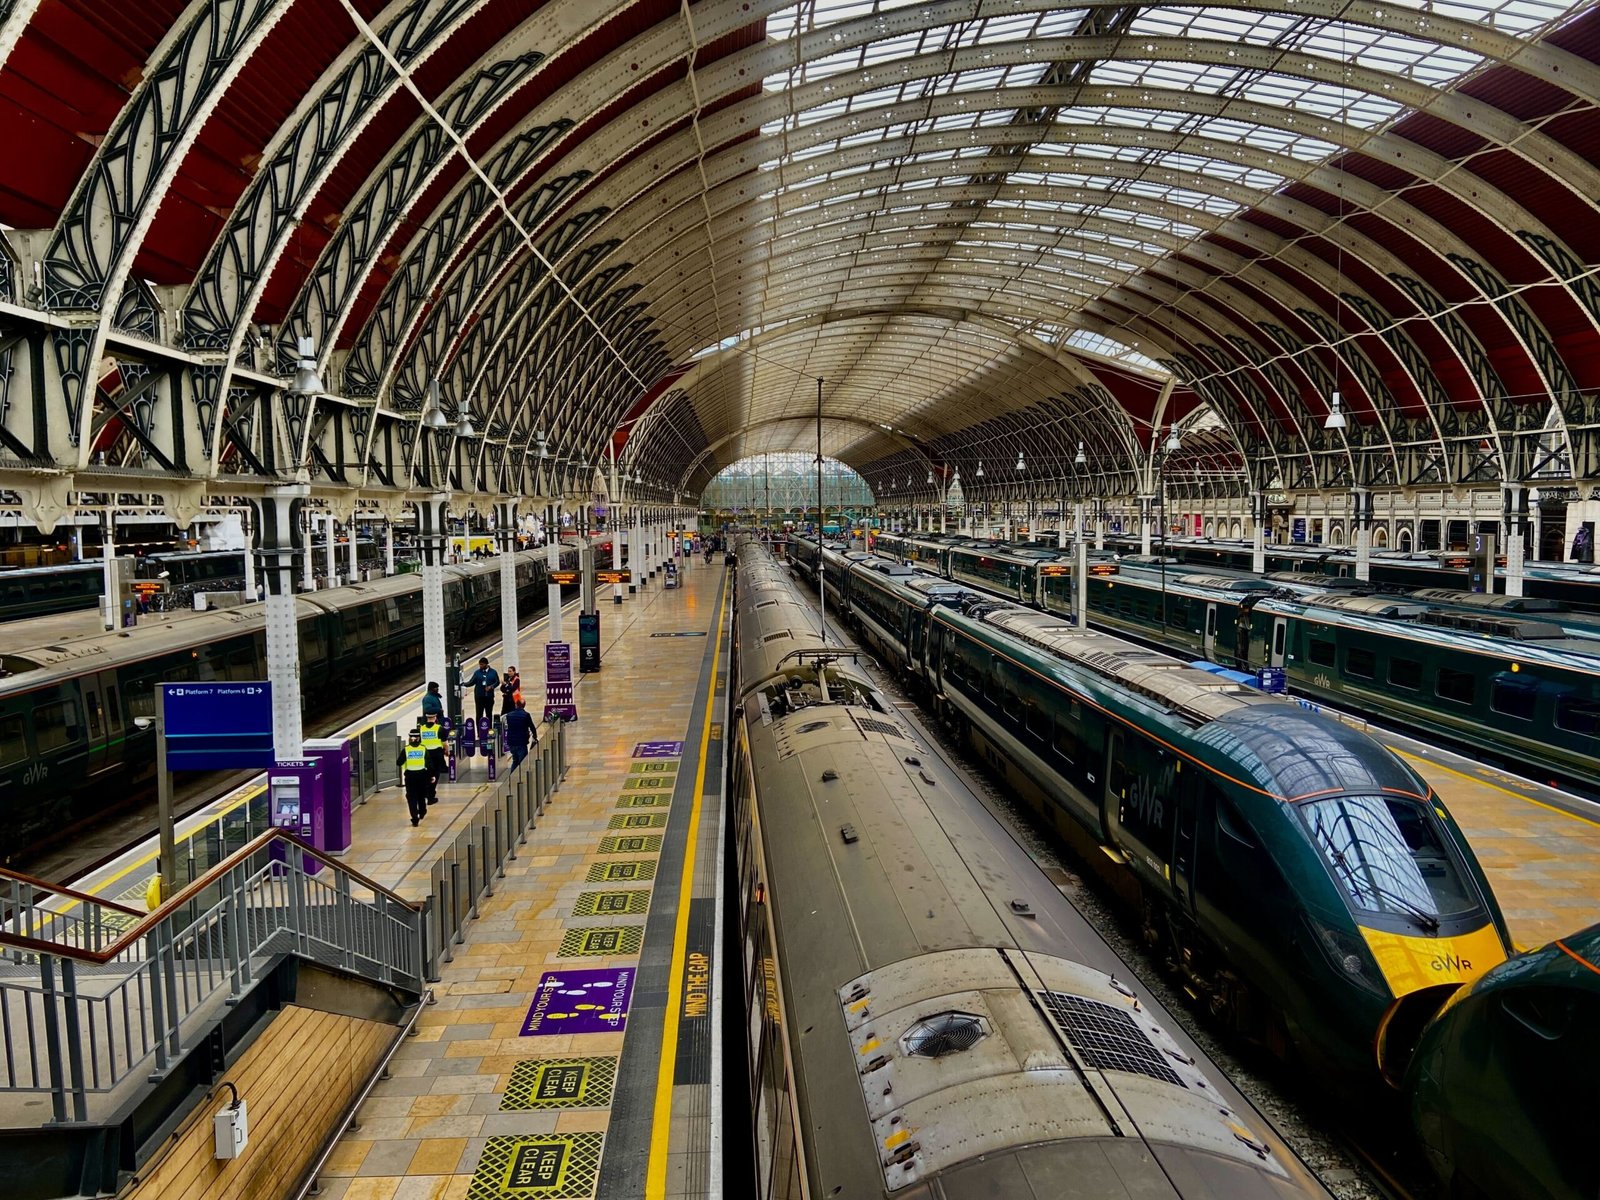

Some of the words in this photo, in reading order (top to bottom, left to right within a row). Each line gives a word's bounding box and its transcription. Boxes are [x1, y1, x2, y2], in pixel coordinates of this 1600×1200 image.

[1314, 672, 1331, 689] GWR
[23, 762, 48, 785] GWR
[1130, 774, 1163, 828] GWR
[688, 953, 708, 972] GAP
[1431, 952, 1472, 973] GWR
[616, 972, 629, 988] MIND
[687, 974, 708, 991] THE
[612, 988, 625, 1006] YOUR
[685, 993, 707, 1016] MIND
[528, 1012, 544, 1030] MIND
[536, 992, 552, 1013] YOUR
[543, 1069, 562, 1096] CLEAR
[562, 1071, 578, 1092] KEEP
[516, 1148, 540, 1184] CLEAR
[538, 1151, 558, 1180] KEEP
